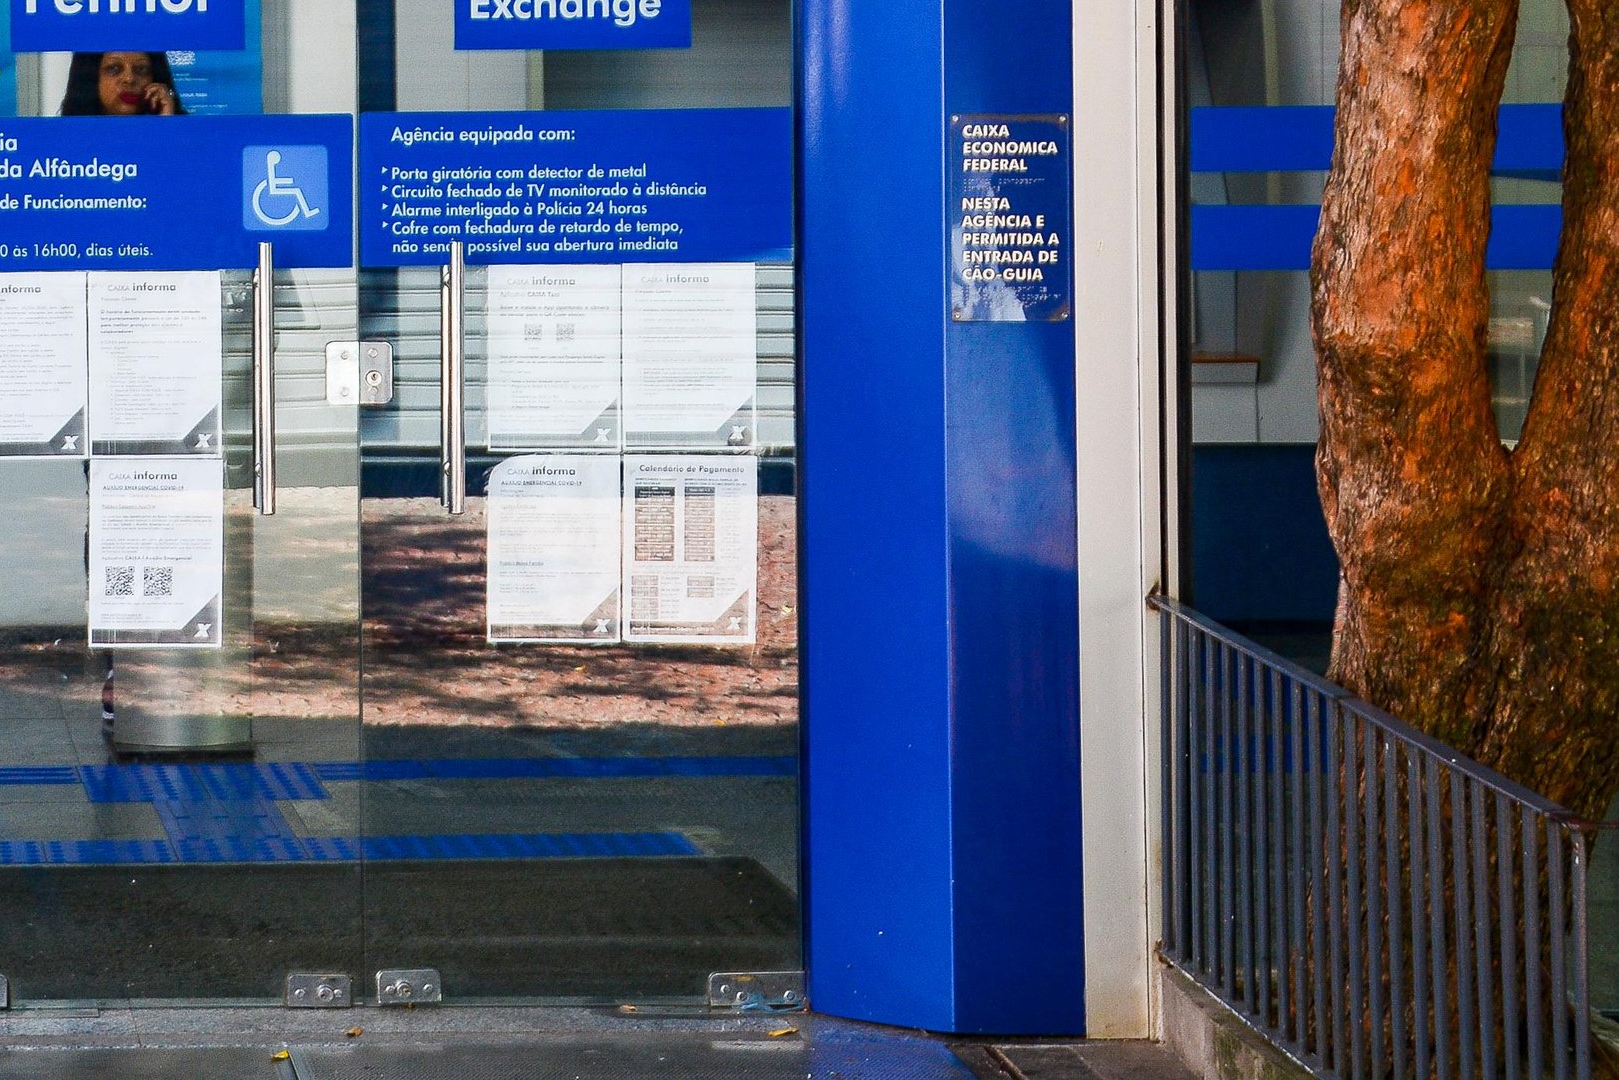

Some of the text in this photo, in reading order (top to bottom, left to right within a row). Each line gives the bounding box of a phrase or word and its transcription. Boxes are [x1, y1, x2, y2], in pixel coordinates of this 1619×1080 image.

[391, 125, 574, 145] Agência equipada com:
[962, 125, 1010, 138] CAIXA
[962, 141, 1058, 155] ECONOMICA
[29, 158, 136, 181] Alfândega
[962, 158, 1028, 172] FEDERAL
[392, 163, 646, 183] Porta giratória com detector de metal
[392, 182, 706, 197] Circuito fechado de TV monitorado à distância
[0, 194, 18, 209] de
[25, 195, 146, 208] Funcionamento:
[962, 198, 1010, 210] NESTA
[392, 200, 647, 218] Alarme interligado à Polícia 24 horas
[392, 219, 682, 235] Cofre com fechadura de retardo de tempo,
[962, 214, 1044, 228] AGÊNCIA E
[393, 240, 418, 252] não
[468, 238, 521, 255] possível
[527, 243, 549, 251] sua
[554, 237, 613, 251] abertura
[619, 236, 677, 250] imediata
[962, 233, 1059, 246] PERMITIDA A
[13, 243, 28, 257] às
[35, 244, 80, 258] 16h00,
[86, 243, 112, 256] dias
[118, 242, 153, 257] úteis.
[963, 250, 1058, 264] ENTRADA DE
[532, 276, 576, 285] informa
[666, 274, 709, 283] informa
[962, 266, 1043, 281] CÃO-GUIA
[133, 282, 176, 291] informa
[134, 471, 177, 480] informa
[532, 466, 576, 475] informa
[699, 465, 744, 474] Pagamento
